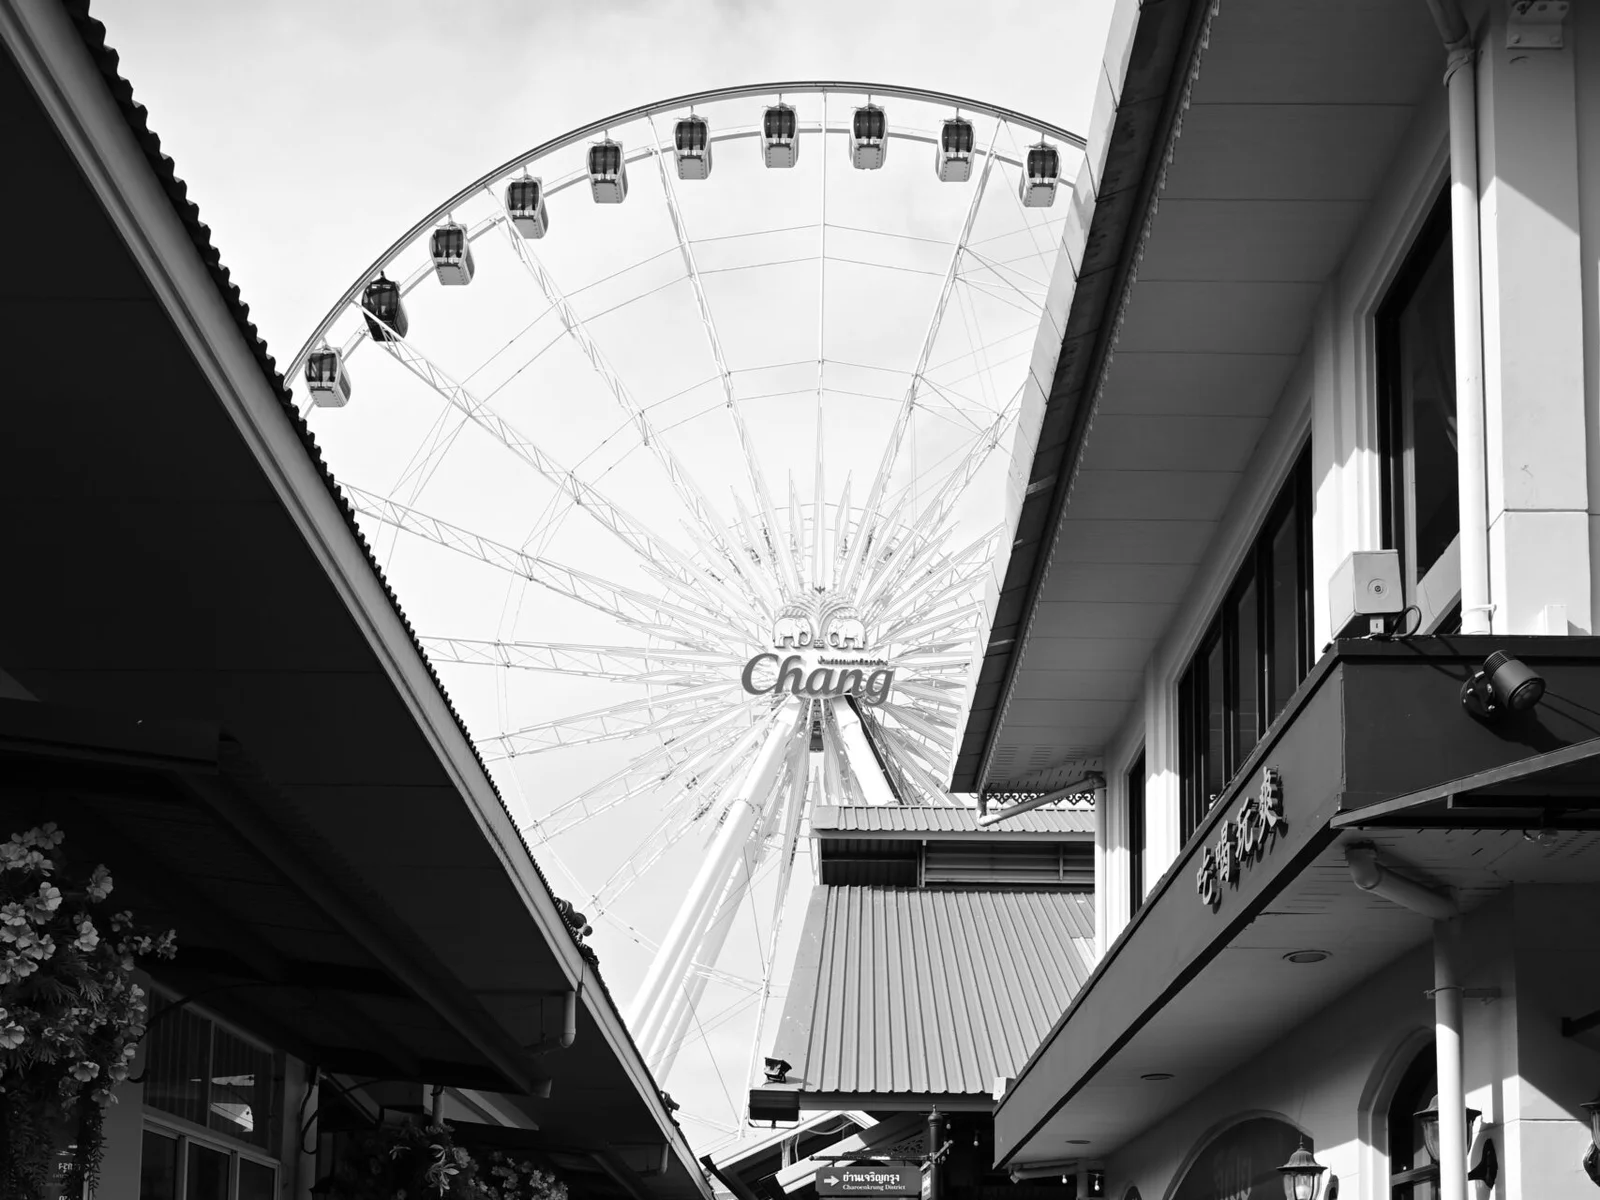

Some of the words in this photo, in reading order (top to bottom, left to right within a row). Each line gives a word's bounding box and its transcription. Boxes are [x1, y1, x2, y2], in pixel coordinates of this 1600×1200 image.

[741, 653, 894, 707] Chang
[1196, 766, 1280, 906] 吃喝玩爽
[842, 1171, 900, 1185] ย่านเจริญกรุง
